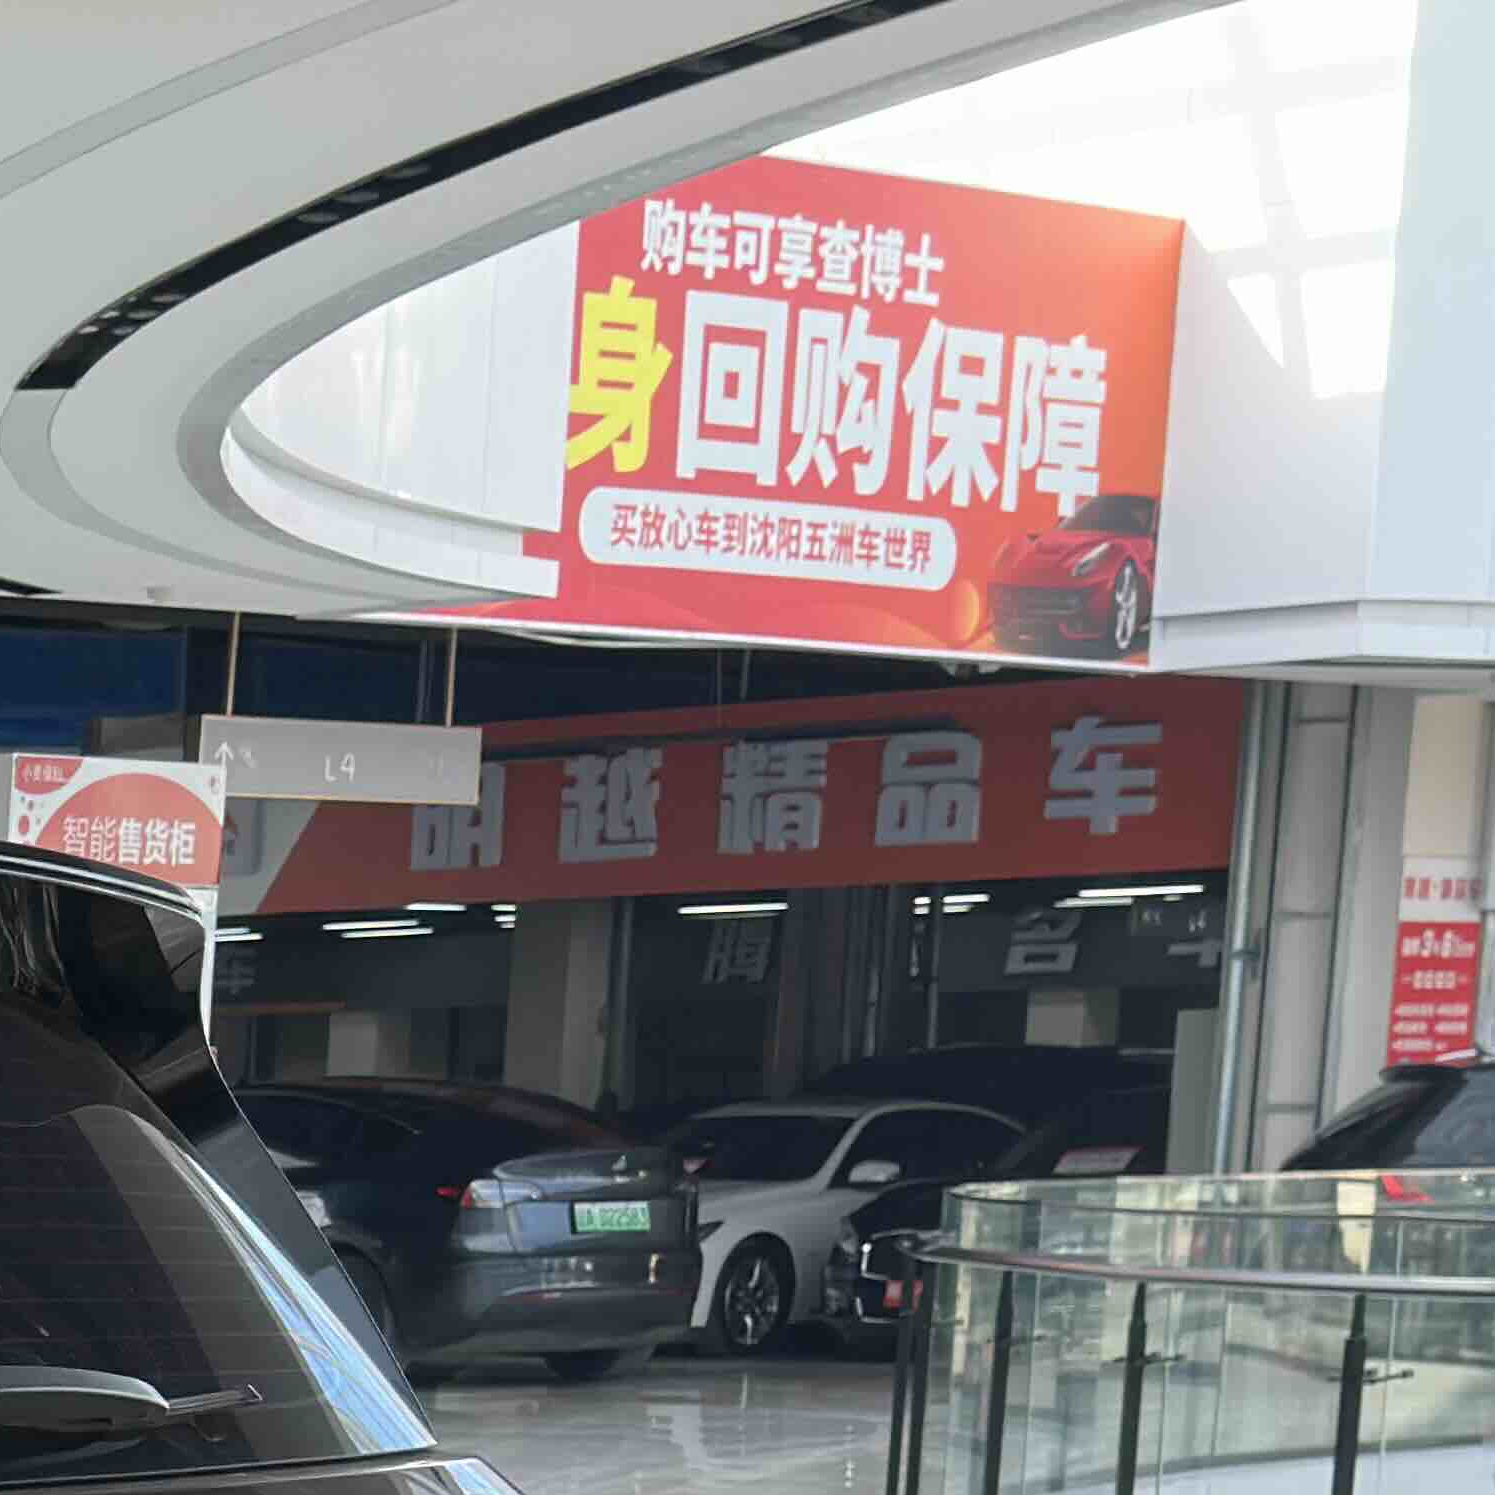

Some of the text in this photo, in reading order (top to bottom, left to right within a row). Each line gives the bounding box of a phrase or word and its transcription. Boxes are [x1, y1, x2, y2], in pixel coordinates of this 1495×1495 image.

[641, 198, 945, 307] 购车可享查博士
[566, 275, 1107, 517] 身回购保障
[610, 502, 933, 575] 买放心车到沈阳五洲车世界
[62, 815, 197, 868] 智能售货柜
